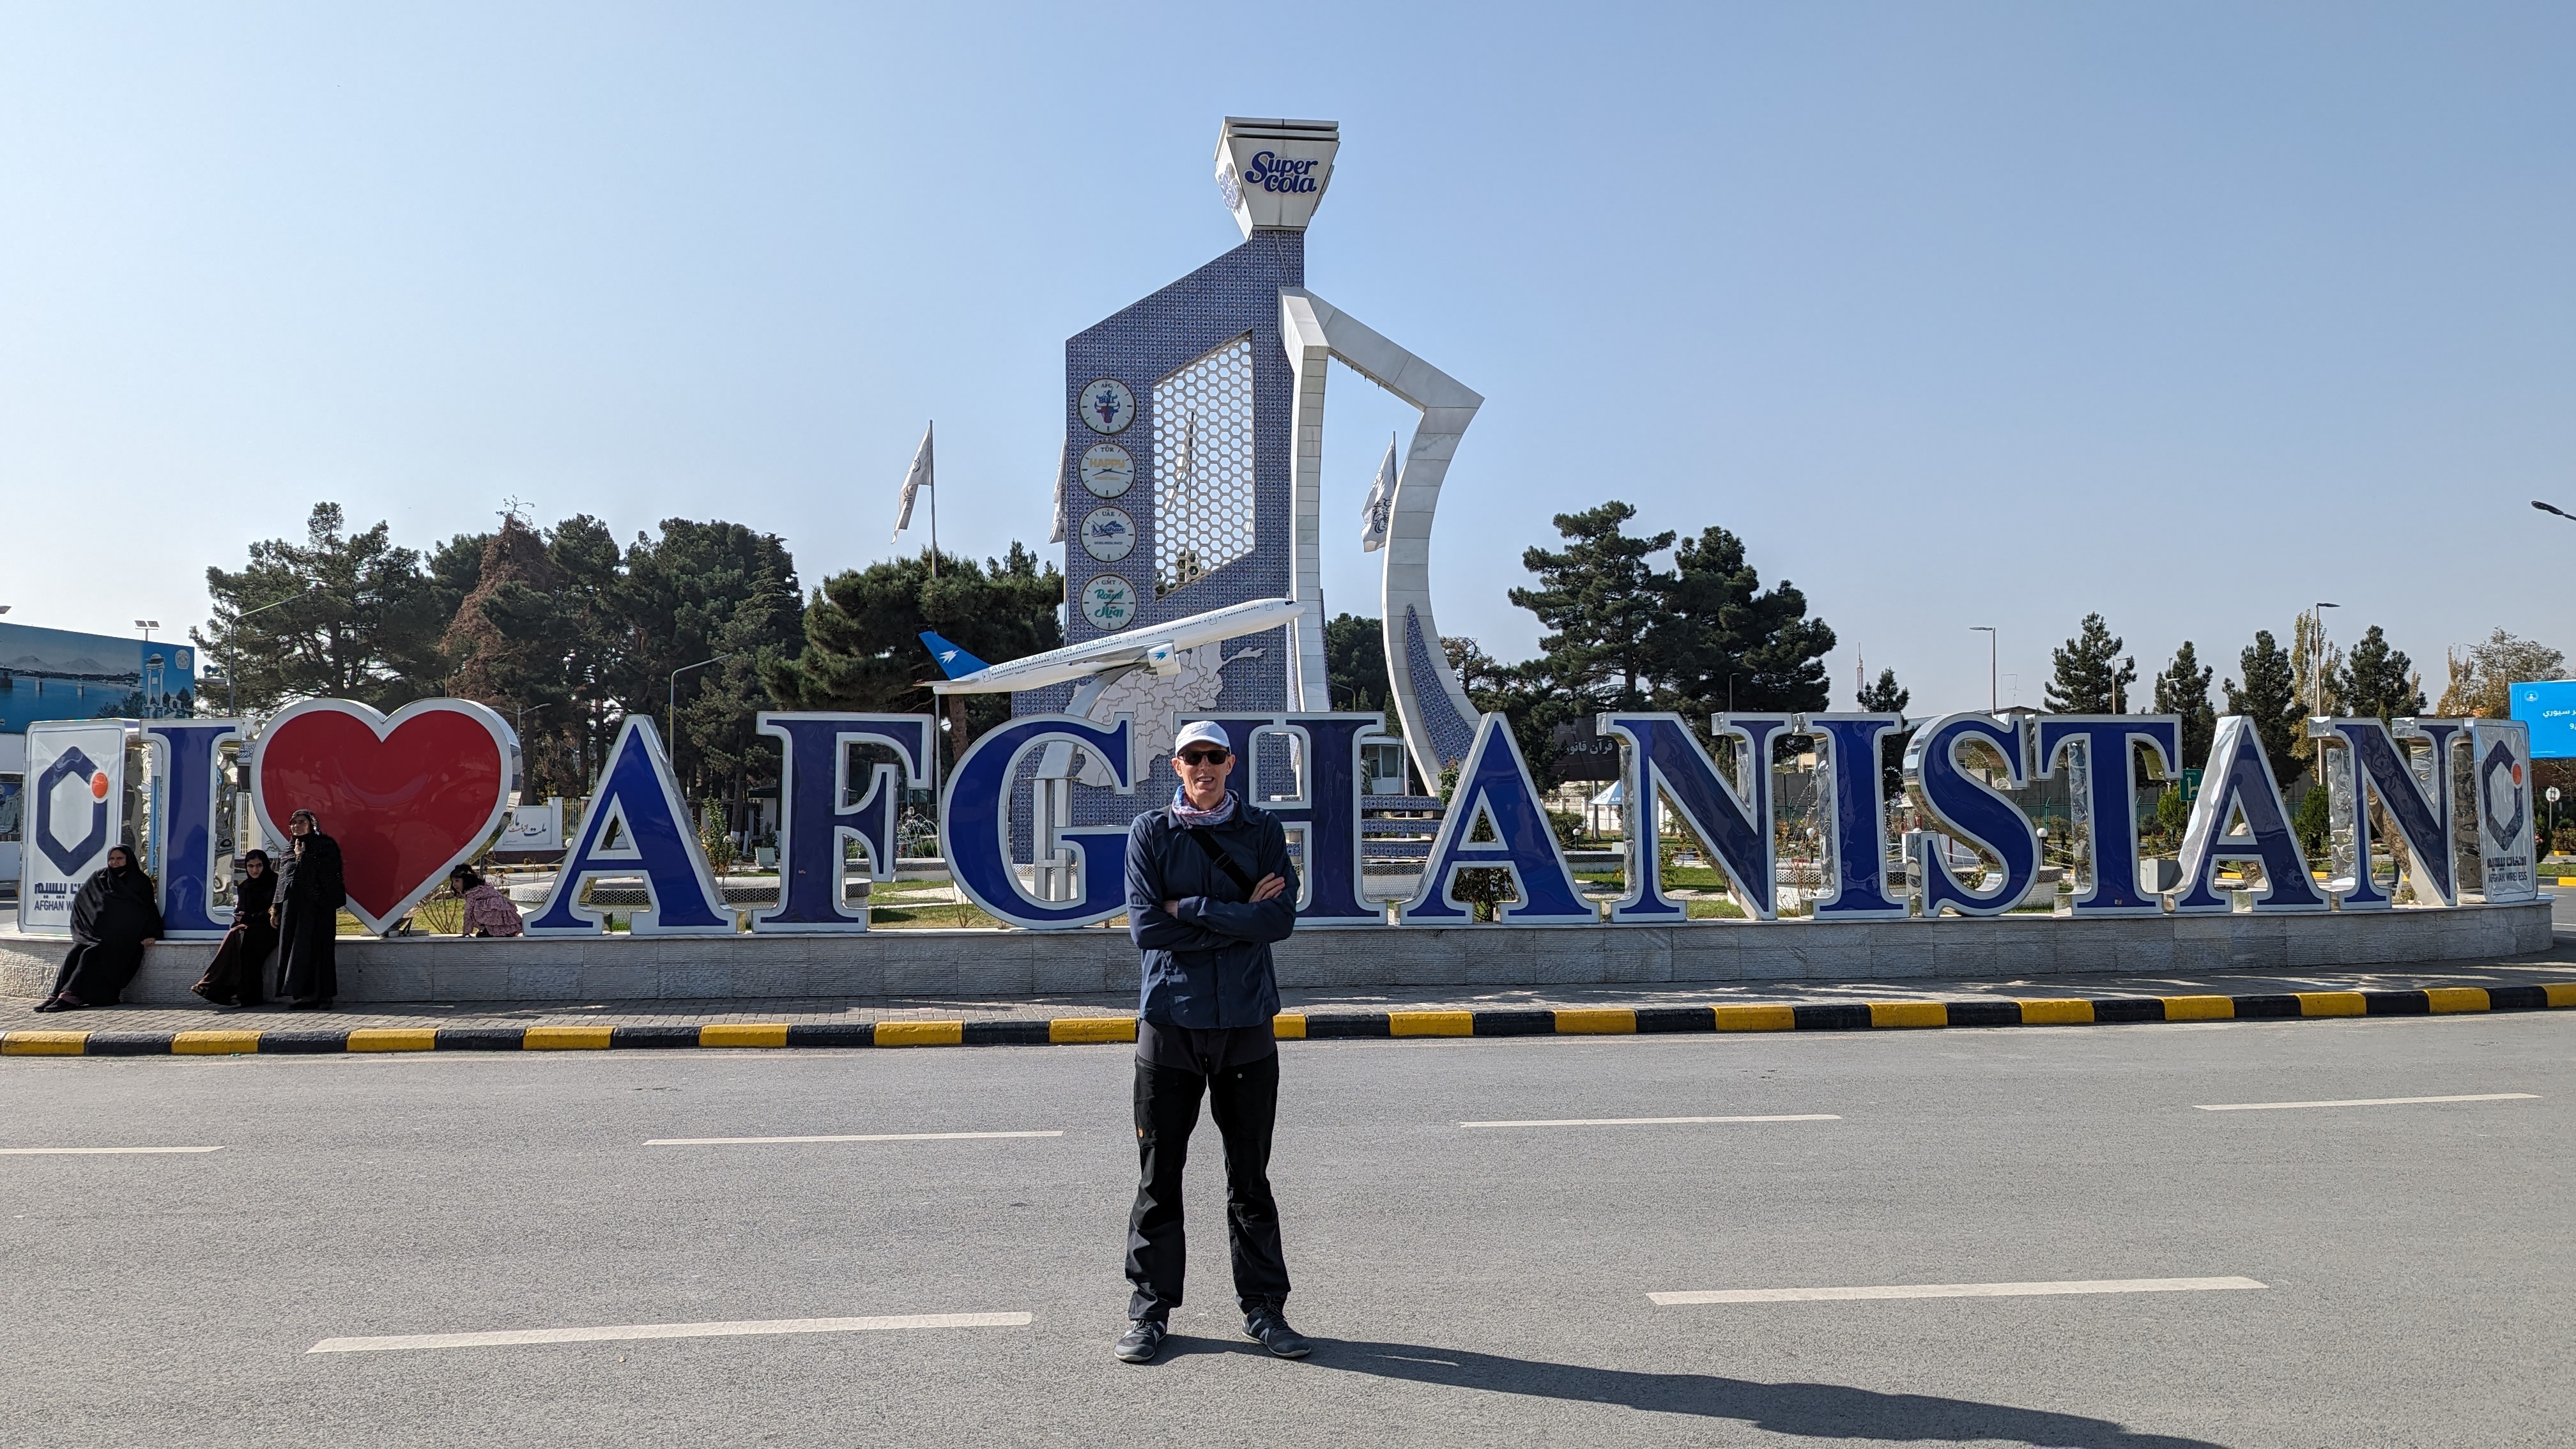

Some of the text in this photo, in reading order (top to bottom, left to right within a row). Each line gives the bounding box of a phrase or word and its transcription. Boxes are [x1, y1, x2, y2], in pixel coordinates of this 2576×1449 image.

[1244, 150, 1319, 185] Super
[1264, 173, 1317, 194] cola
[1089, 458, 1125, 469] HAPPY
[1094, 588, 1124, 600] Royal
[991, 635, 1122, 673] ARIANA AFGHAN AIRLINES
[1590, 738, 1613, 755] قرآن
[140, 711, 2464, 939] I AFGHANISTAN
[2488, 873, 2506, 883] AFGHAN
[34, 900, 65, 911] AFGHAN
